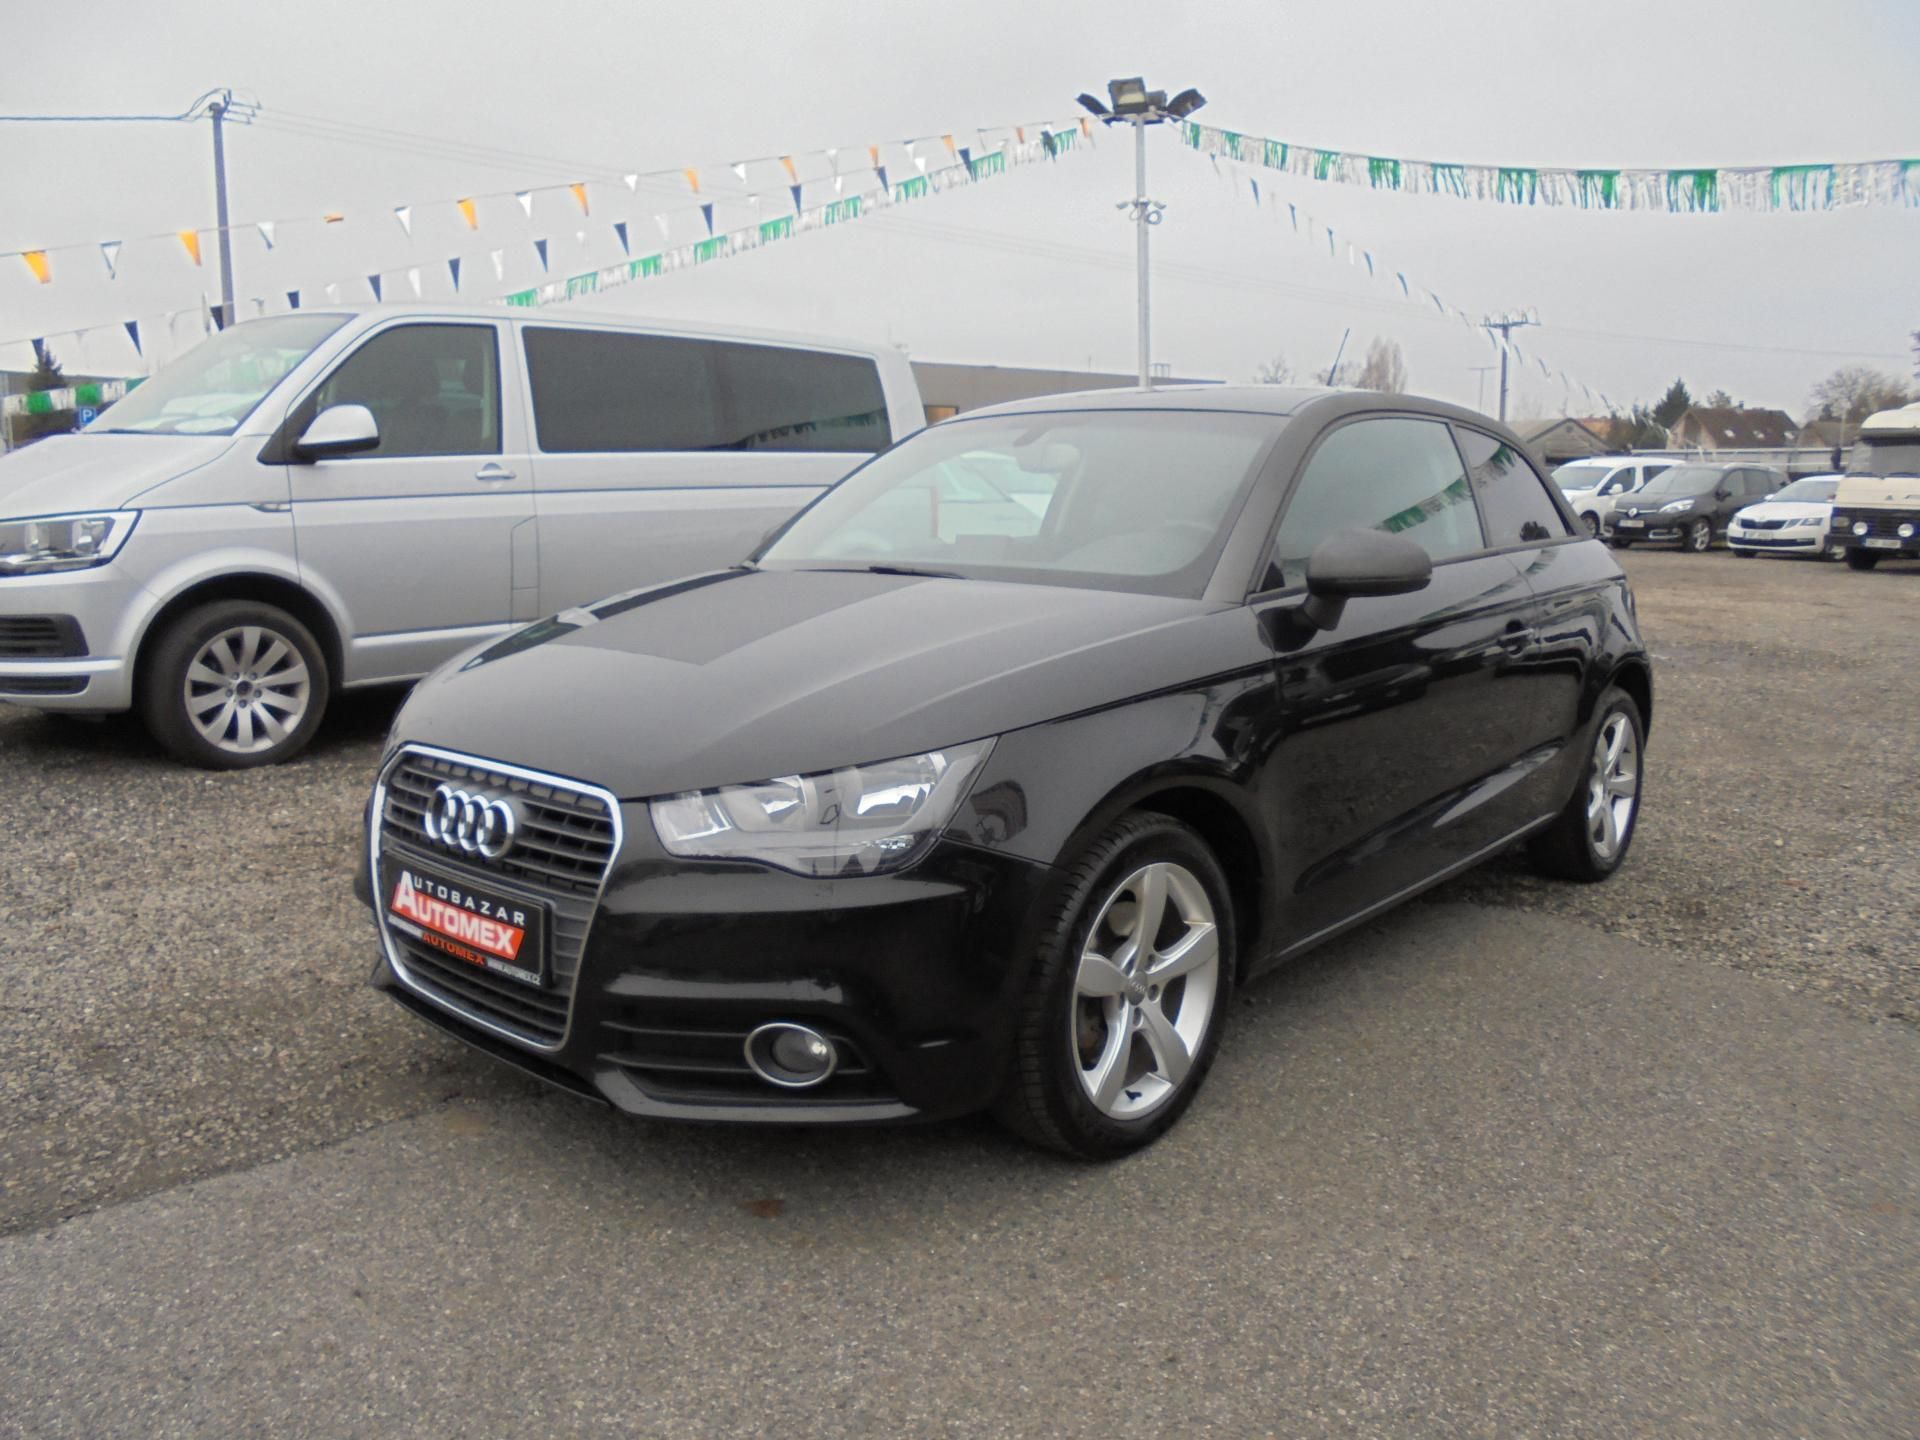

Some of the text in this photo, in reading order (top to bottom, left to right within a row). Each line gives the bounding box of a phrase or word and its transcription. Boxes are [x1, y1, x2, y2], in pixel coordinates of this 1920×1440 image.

[82, 408, 93, 422] P
[394, 870, 515, 955] AUTOMEX
[422, 932, 486, 966] AUTOMEX
